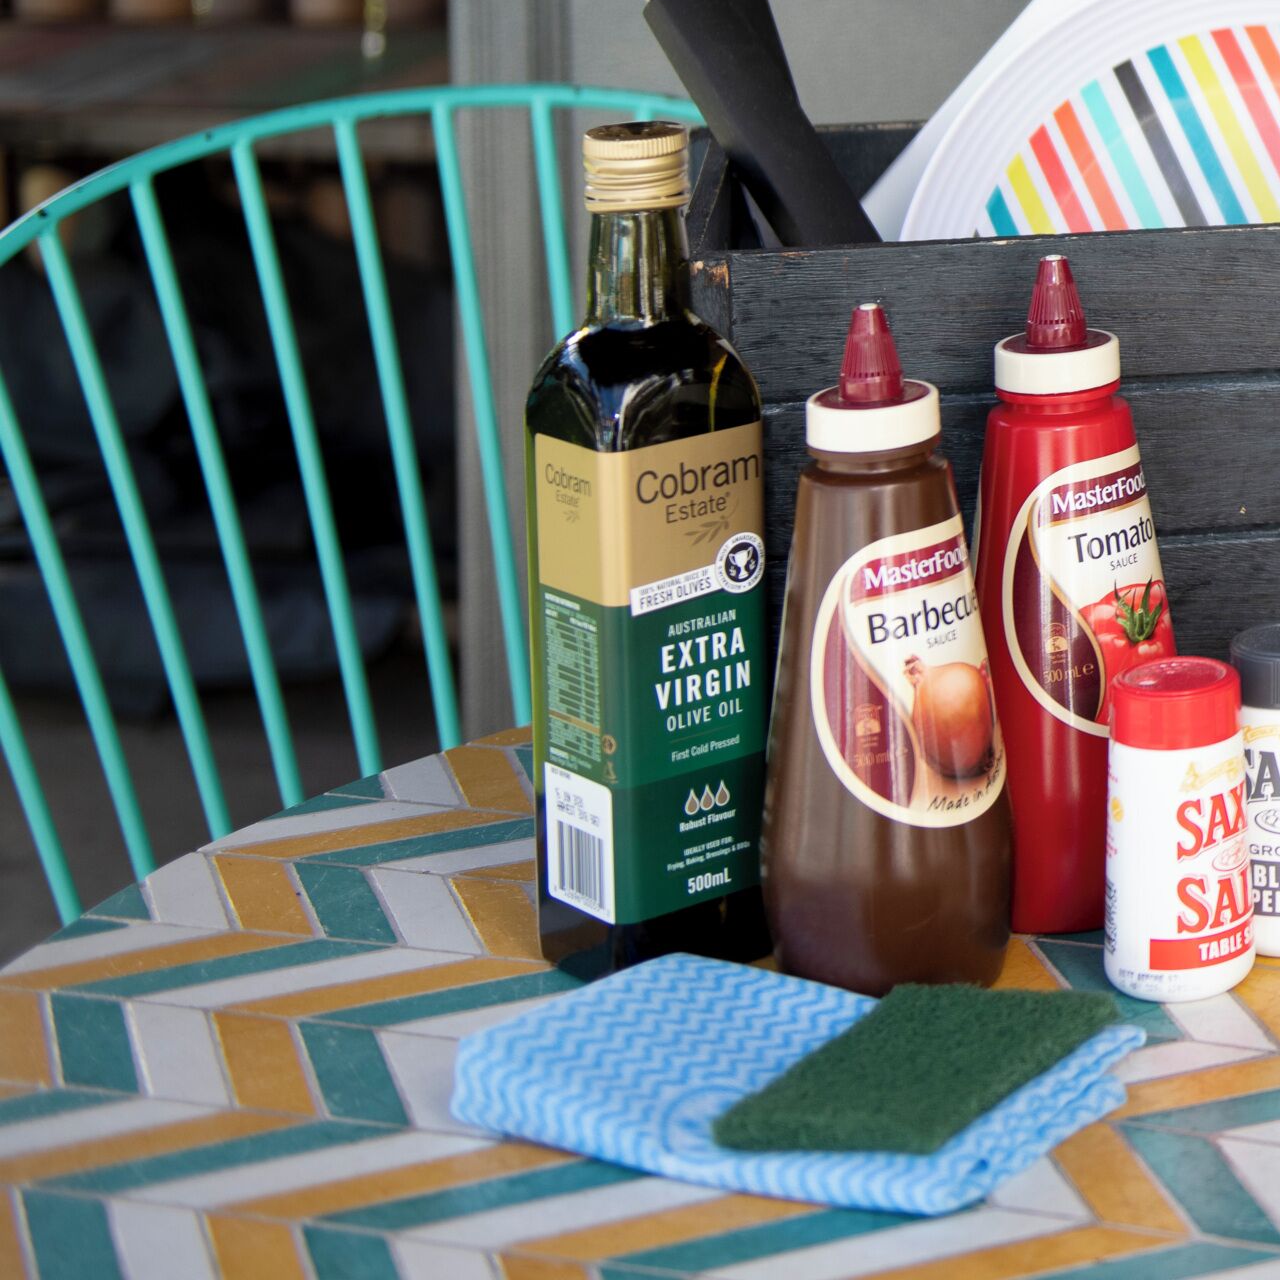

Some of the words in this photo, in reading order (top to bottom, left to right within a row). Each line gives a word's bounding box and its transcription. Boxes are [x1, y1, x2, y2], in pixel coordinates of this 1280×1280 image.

[545, 463, 592, 498] Cobram
[635, 453, 760, 505] Cobram
[1067, 516, 1154, 563] Tomato
[1110, 553, 1138, 571] SAUCE
[640, 589, 673, 609] FRESH
[676, 577, 712, 598] OLIVES
[668, 609, 737, 637] AUSTRALIAN
[926, 628, 957, 649] SAUCE
[661, 626, 745, 674] EXTRA
[655, 659, 751, 711] VIRGIN
[666, 705, 711, 732] OLIVE
[718, 697, 743, 718] OIL
[671, 746, 689, 762] First
[691, 742, 708, 757] Cold
[710, 734, 740, 750] Pressed
[927, 792, 969, 812] Made
[680, 816, 706, 832] Robust
[707, 808, 736, 824] Flavour
[688, 867, 732, 894] 500mL
[1198, 930, 1243, 961] TABLE
